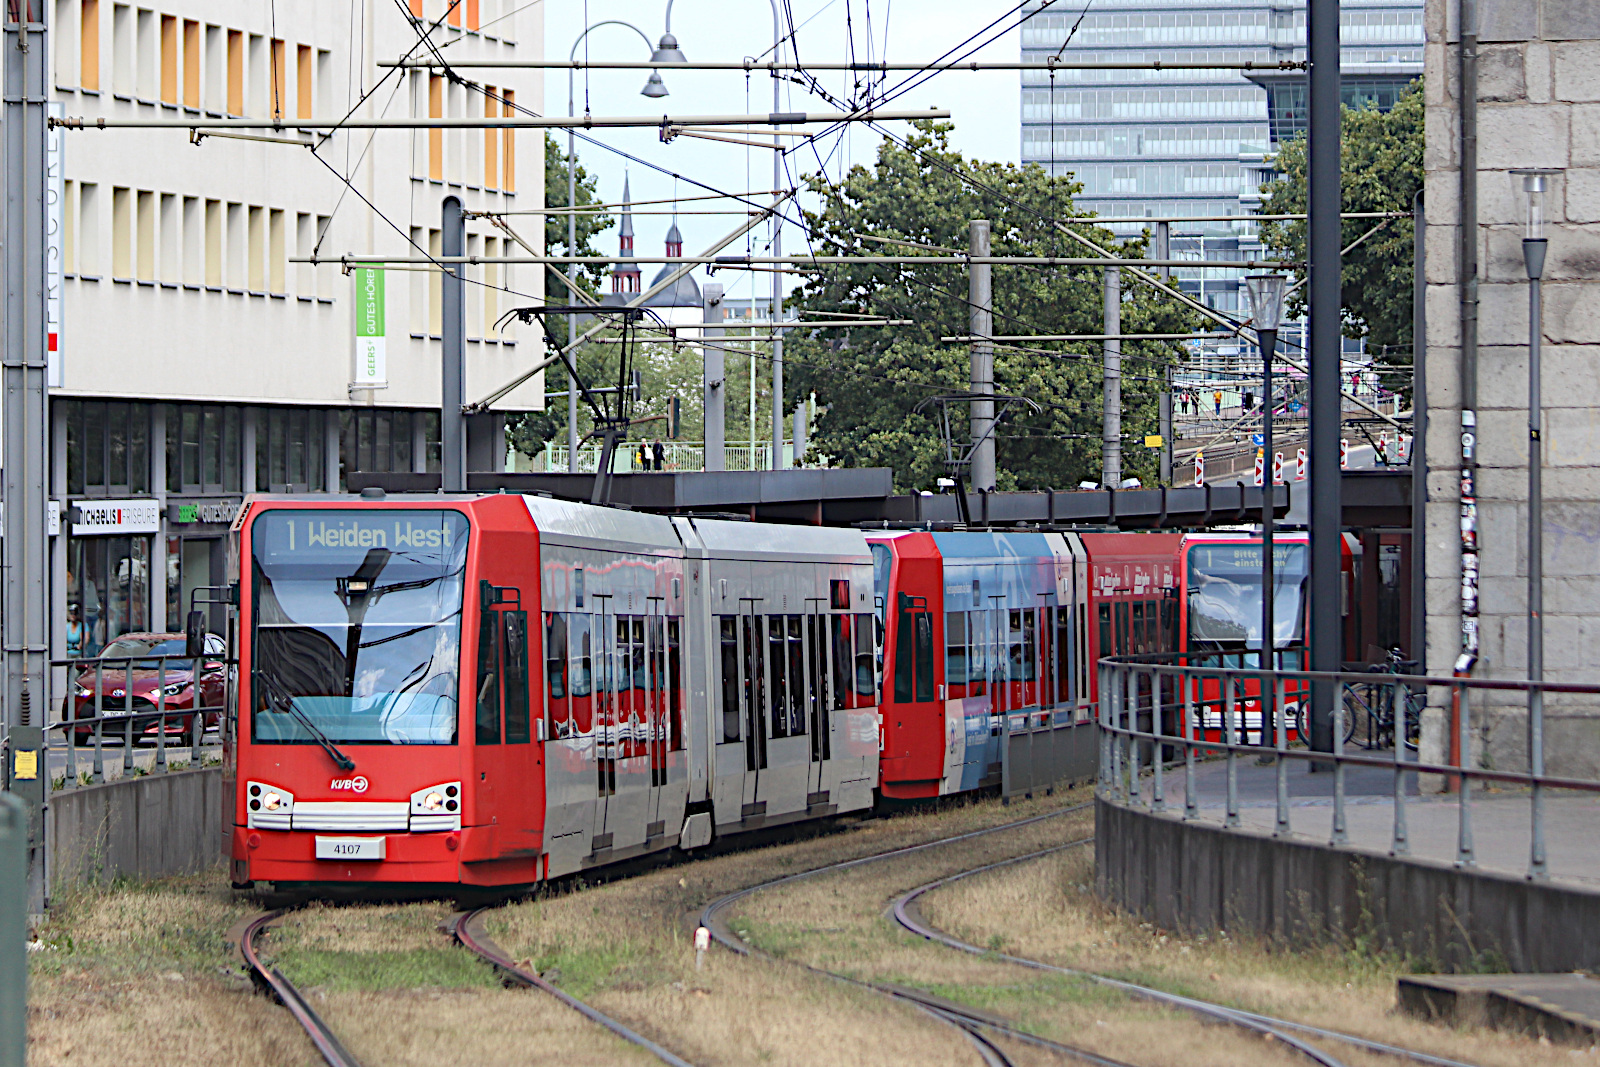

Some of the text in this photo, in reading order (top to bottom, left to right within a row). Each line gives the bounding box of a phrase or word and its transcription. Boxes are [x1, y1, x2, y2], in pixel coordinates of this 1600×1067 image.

[366, 302, 376, 335] GUTES
[367, 345, 376, 377] GEERS
[287, 520, 451, 550] 1 Weiden West
[1207, 550, 1212, 568] 1
[1233, 550, 1258, 559] Bitte
[330, 779, 352, 790] KVB
[333, 844, 361, 855] 4107
